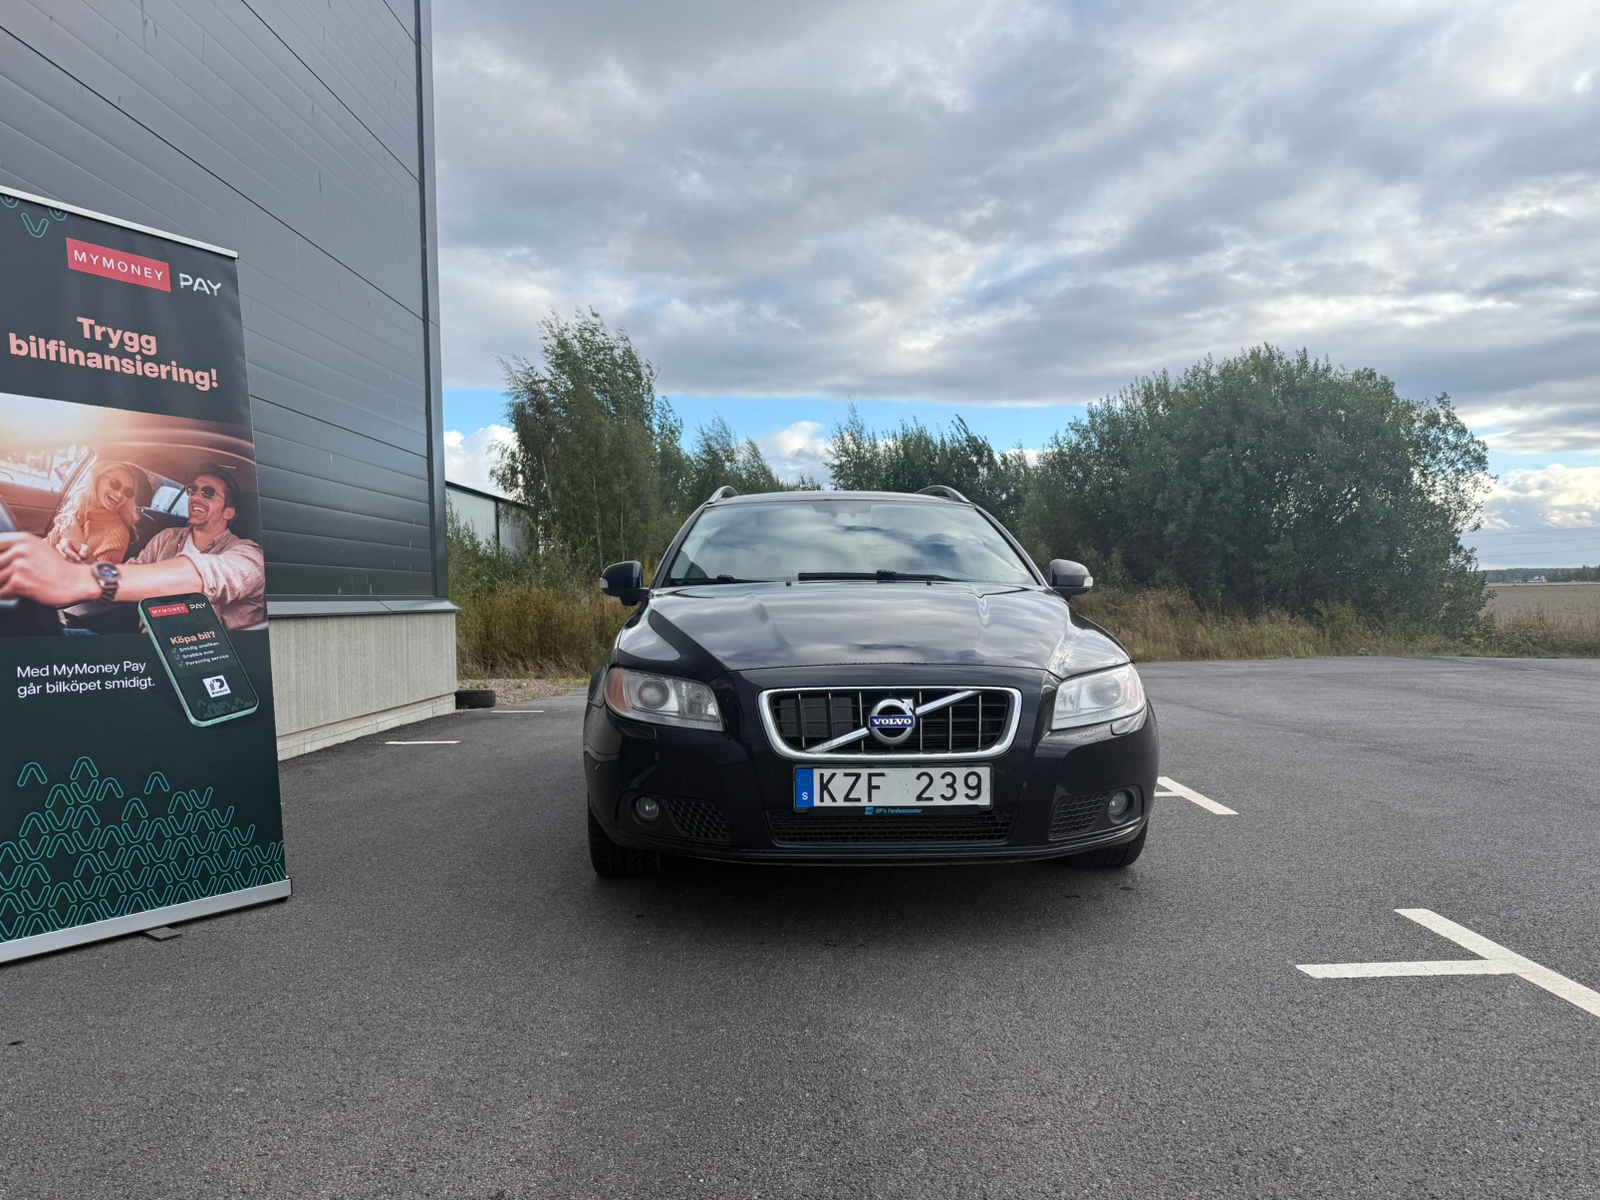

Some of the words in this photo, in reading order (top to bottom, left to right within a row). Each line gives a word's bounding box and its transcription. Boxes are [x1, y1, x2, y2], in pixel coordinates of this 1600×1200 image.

[74, 249, 163, 281] MYMONEY
[179, 273, 221, 296] PAY
[77, 316, 157, 356] Trygg
[9, 332, 218, 391] bilfinansiering!
[151, 606, 186, 614] MYMONEY
[170, 635, 197, 645] Köpa
[197, 631, 216, 640] bil?
[17, 665, 49, 678] Med
[53, 662, 120, 678] MyMoney
[123, 660, 146, 675] Pay
[17, 682, 42, 698] går
[46, 680, 102, 695] bilköpet
[104, 677, 155, 692] smidigt.
[802, 792, 808, 800] S
[819, 772, 887, 803] KZF
[915, 771, 982, 802] 239
